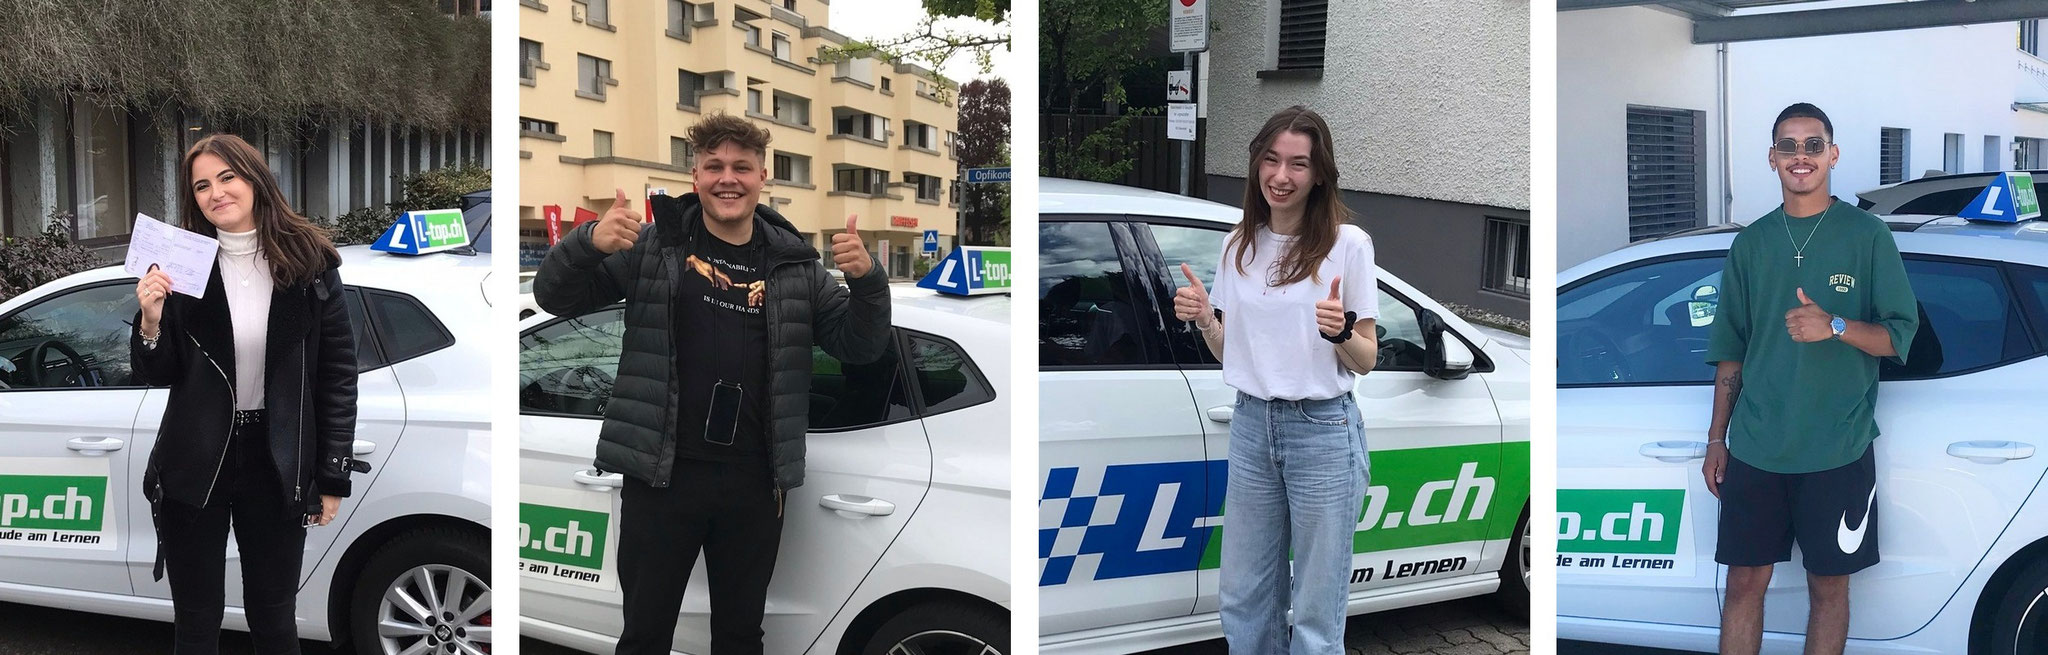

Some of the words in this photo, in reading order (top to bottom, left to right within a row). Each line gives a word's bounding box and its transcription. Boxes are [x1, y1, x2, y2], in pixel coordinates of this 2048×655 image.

[1981, 186, 2004, 216] L
[389, 224, 408, 249] L
[417, 218, 463, 245] L-top.ch
[937, 259, 957, 288] L
[719, 301, 735, 310] OUR
[28, 532, 47, 542] am
[52, 531, 101, 544] Lernen
[529, 563, 549, 575] am
[553, 565, 601, 583] Lernen
[1382, 556, 1467, 580] Lernen
[1579, 557, 1606, 568] am
[1612, 555, 1675, 569] Lernen
